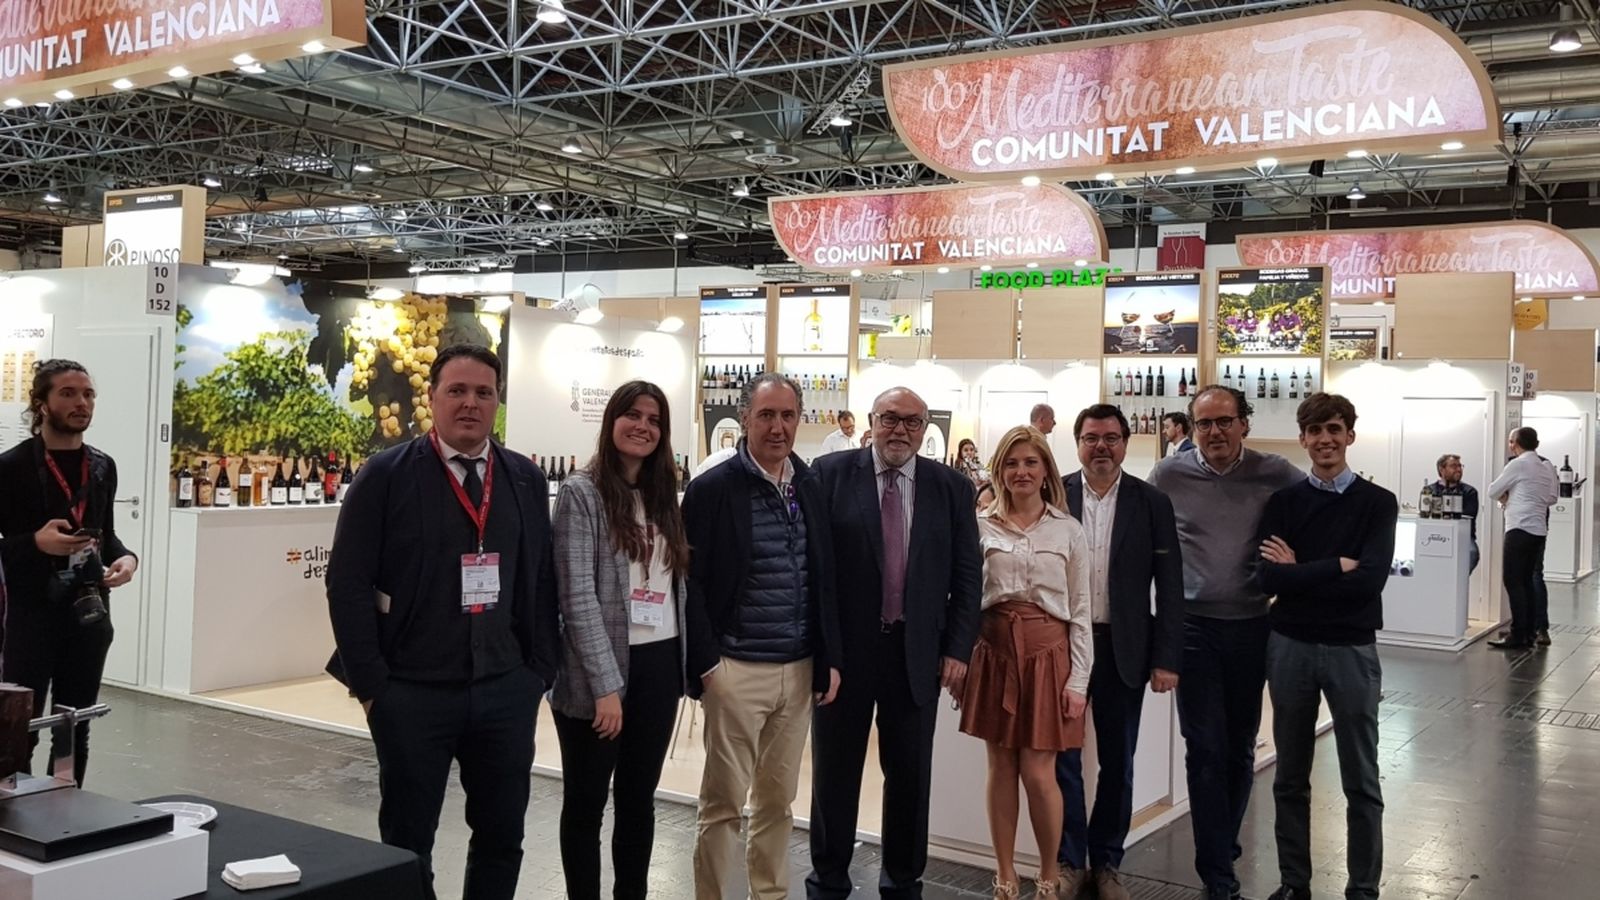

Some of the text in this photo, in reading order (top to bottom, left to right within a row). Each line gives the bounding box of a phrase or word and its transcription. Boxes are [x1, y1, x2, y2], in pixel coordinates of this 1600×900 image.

[0, 0, 281, 79] UNITAT VALENCIANA
[936, 63, 1272, 150] Mediterranean
[1252, 25, 1395, 105] Taste
[972, 96, 1446, 166] COMUNITAT VALENCIANA
[794, 203, 979, 252] Mediterranean
[968, 191, 1041, 237] Taste
[131, 248, 180, 265] PINOSO
[814, 235, 1066, 264] COMUNITAT VALENCIANA
[1471, 232, 1551, 272] Taste
[155, 266, 168, 278] 10
[981, 268, 1123, 289] FOOD PLAZ
[156, 283, 165, 294] D
[149, 299, 170, 311] 152
[1525, 372, 1534, 380] 10
[1508, 386, 1521, 394] 172
